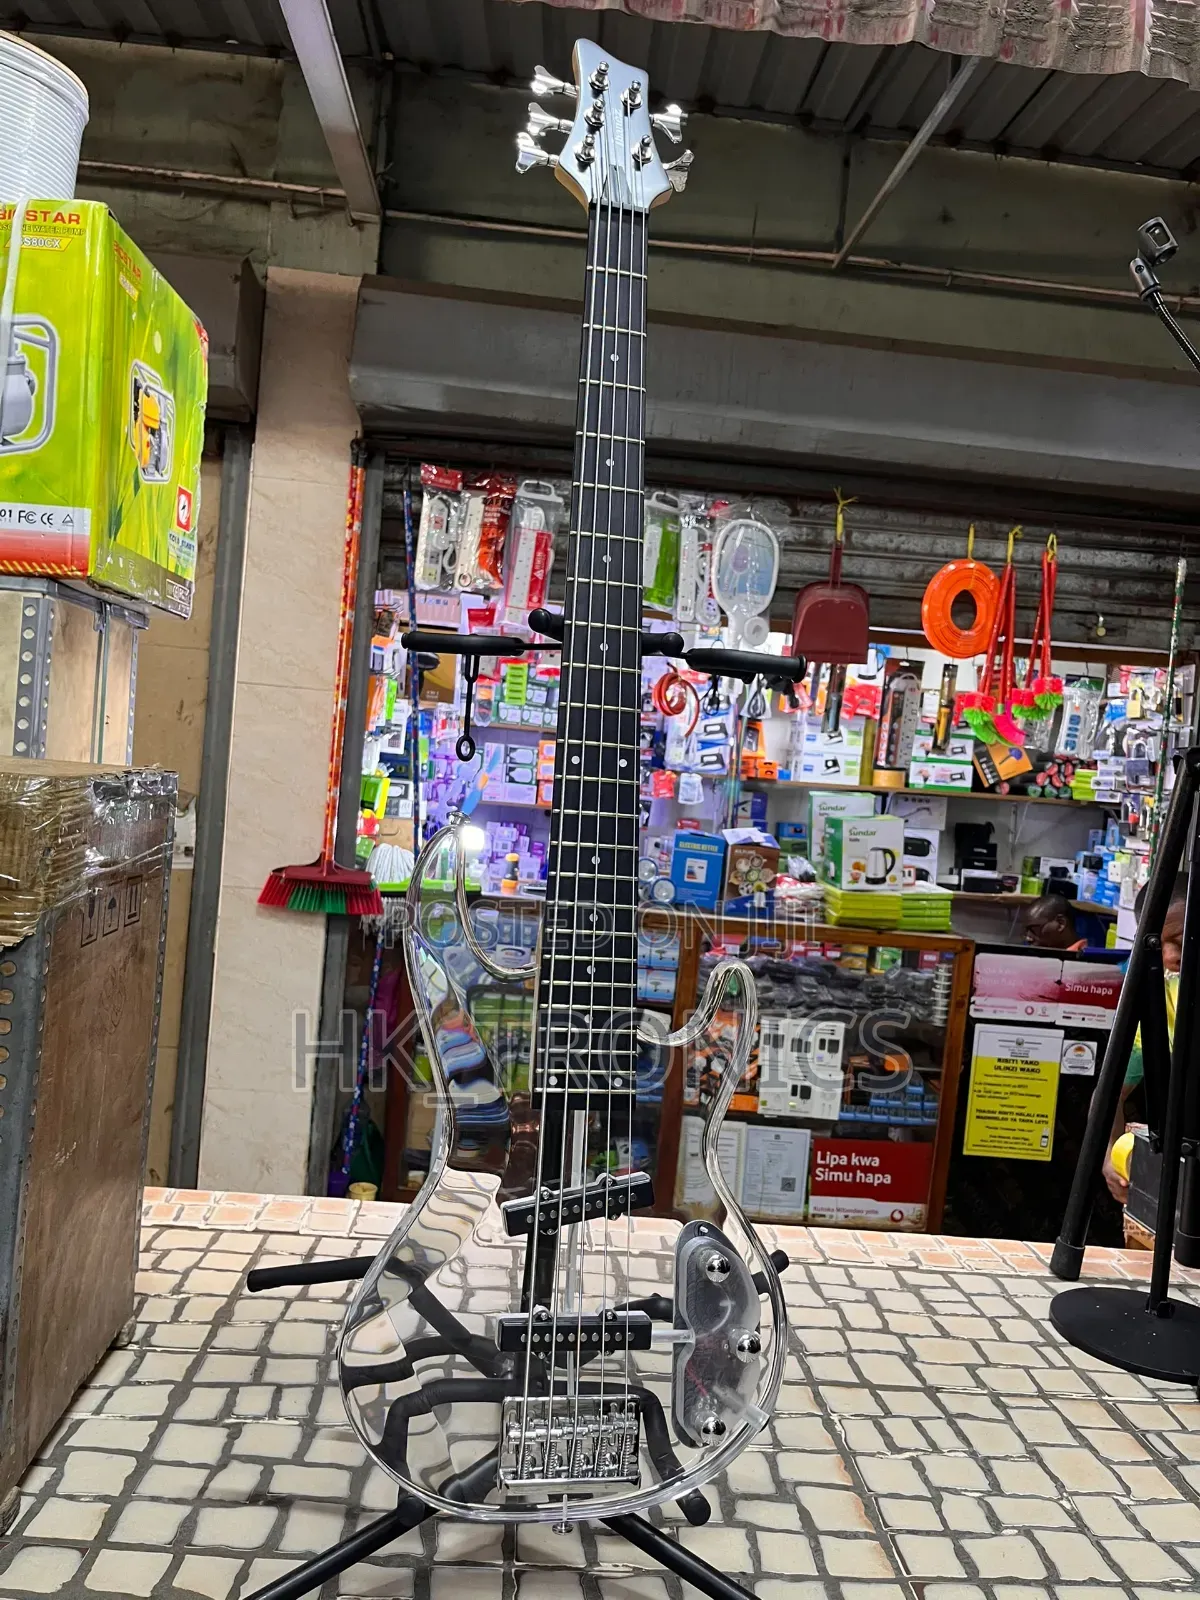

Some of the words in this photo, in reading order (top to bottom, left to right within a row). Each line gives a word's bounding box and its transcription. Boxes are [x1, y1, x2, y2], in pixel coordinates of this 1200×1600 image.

[1064, 982, 1089, 993] Simu
[1090, 984, 1113, 996] hapa
[816, 1150, 848, 1168] Lipa
[851, 1152, 880, 1167] kwa
[815, 1167, 853, 1183] Simu
[856, 1169, 892, 1187] hapa
